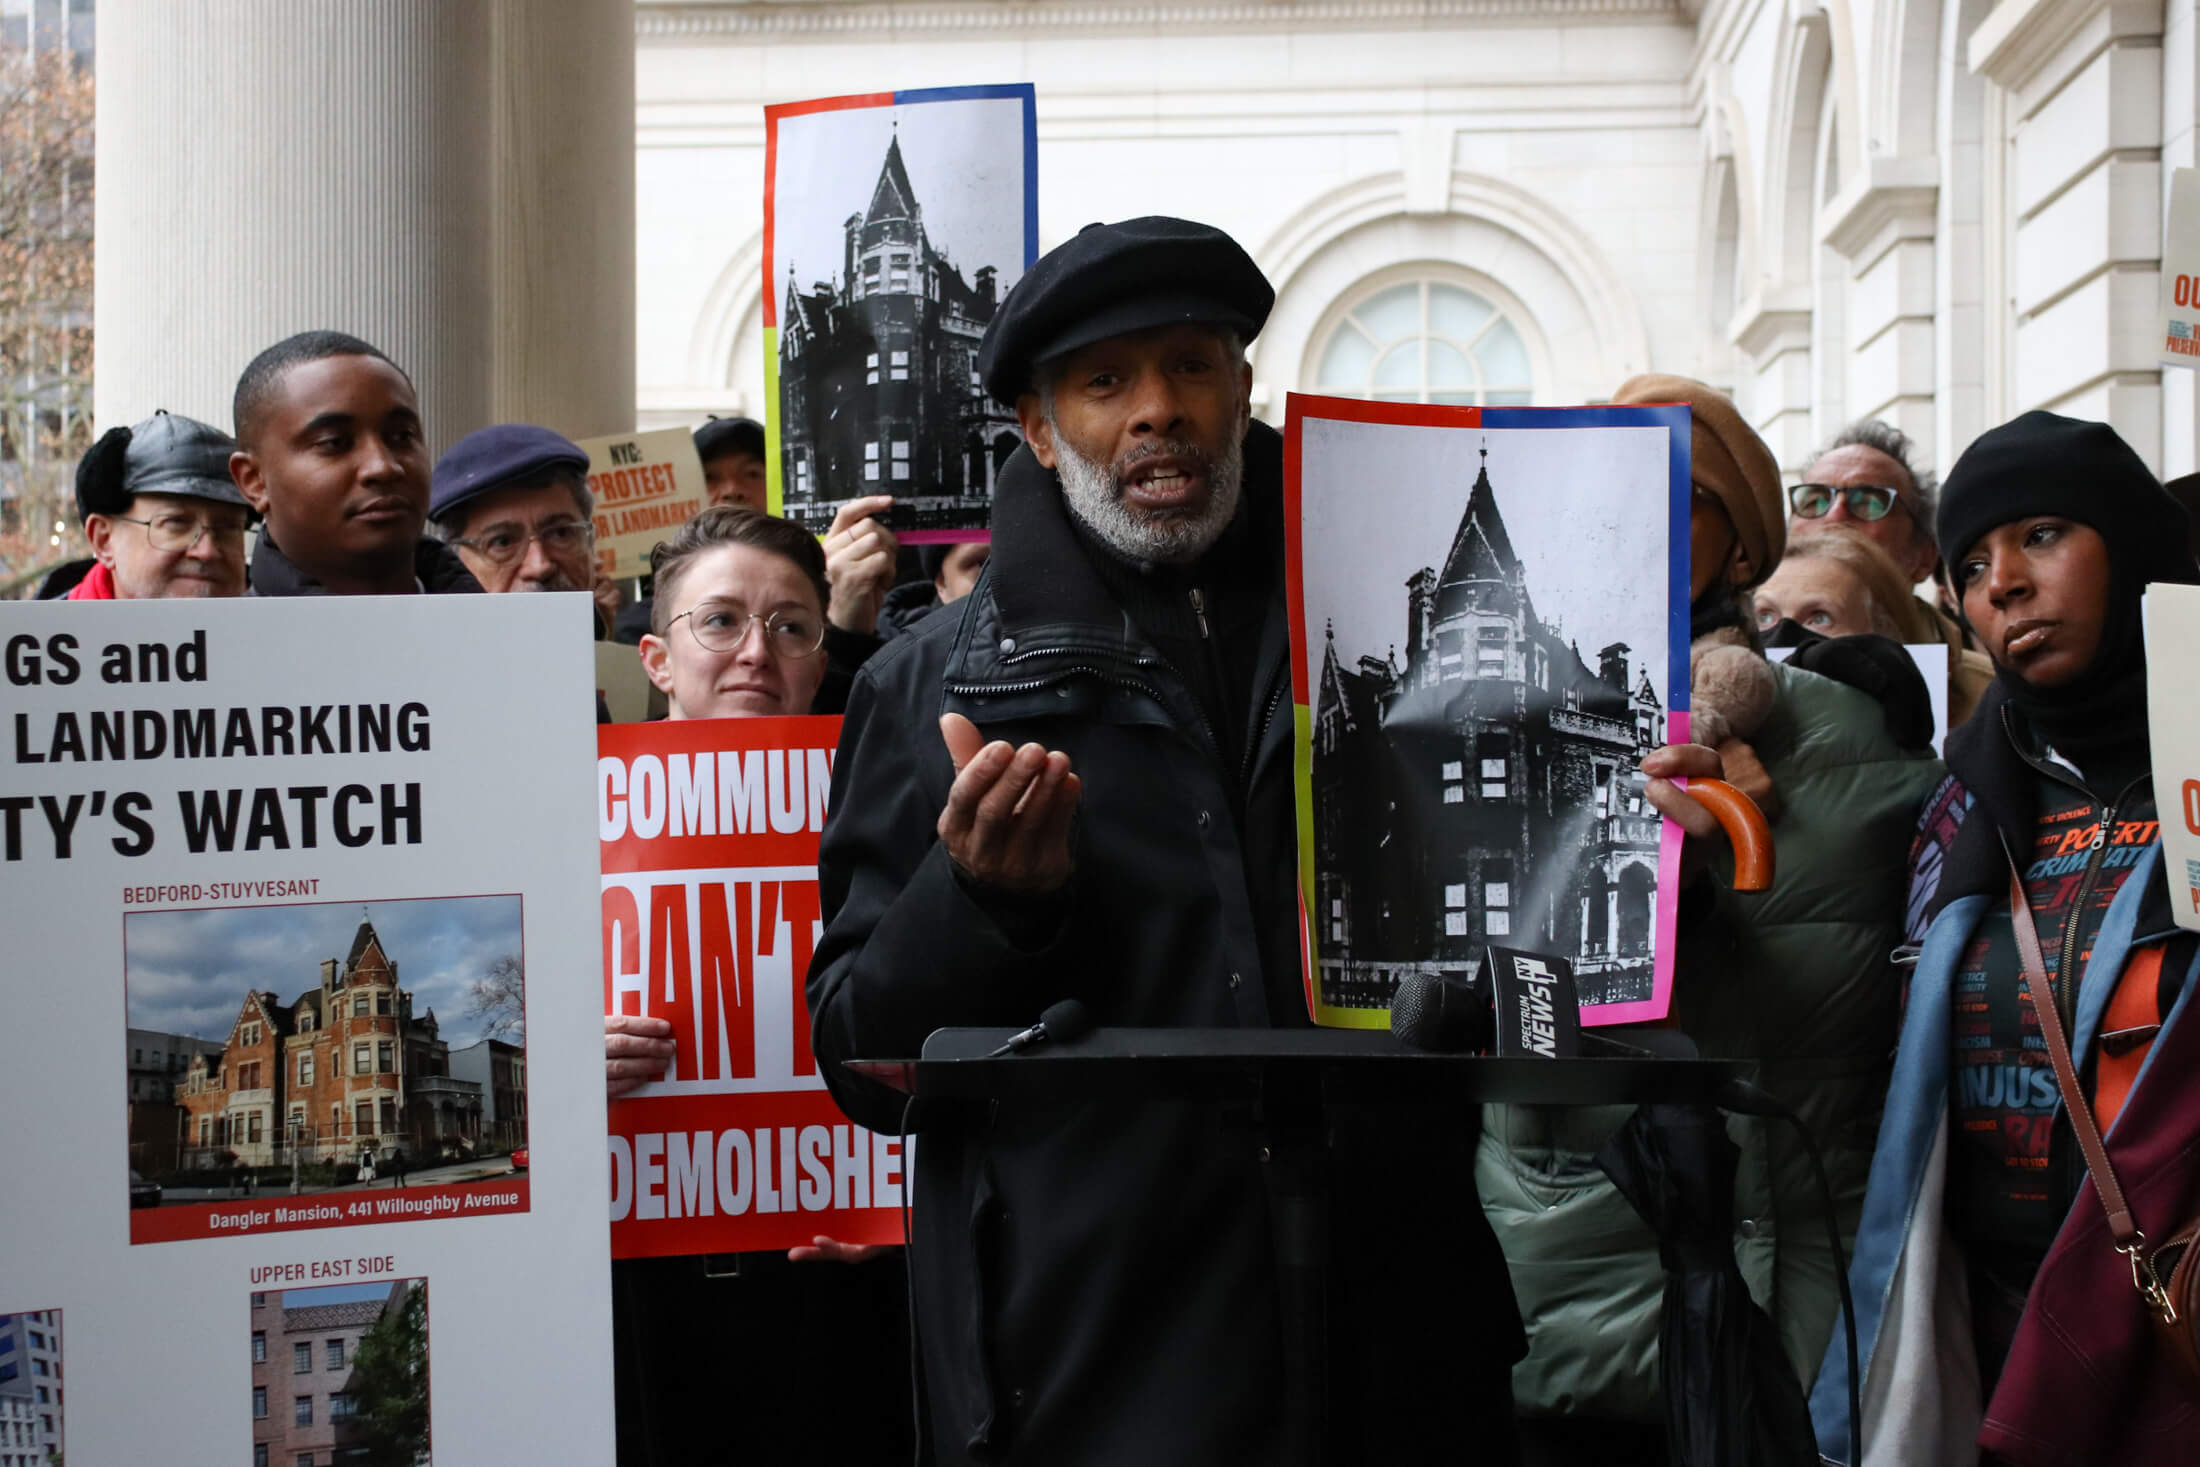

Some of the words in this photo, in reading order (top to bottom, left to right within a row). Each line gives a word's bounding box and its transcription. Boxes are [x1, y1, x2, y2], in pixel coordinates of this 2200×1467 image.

[588, 463, 676, 501] PROTECT
[610, 442, 642, 466] NYC:
[5, 634, 80, 686] GS
[101, 630, 207, 683] and
[15, 703, 430, 763] LANDMARKING
[0, 791, 154, 861] TY'S
[178, 783, 421, 853] WATCH
[124, 880, 320, 904] BEDFORD-STUYVESANT
[602, 880, 820, 1081] CAN'T
[1519, 994, 1533, 1051] SPECTRUM
[1528, 982, 1557, 1059] NEWS
[210, 1210, 270, 1229] Dangler
[275, 1204, 343, 1222] Mansion,
[348, 1202, 372, 1217] 441
[376, 1195, 460, 1214] Willoughby
[465, 1193, 519, 1208] Avenue
[250, 1264, 305, 1284] UPPER
[311, 1259, 352, 1278] EAST
[358, 1256, 394, 1274] SIDE
